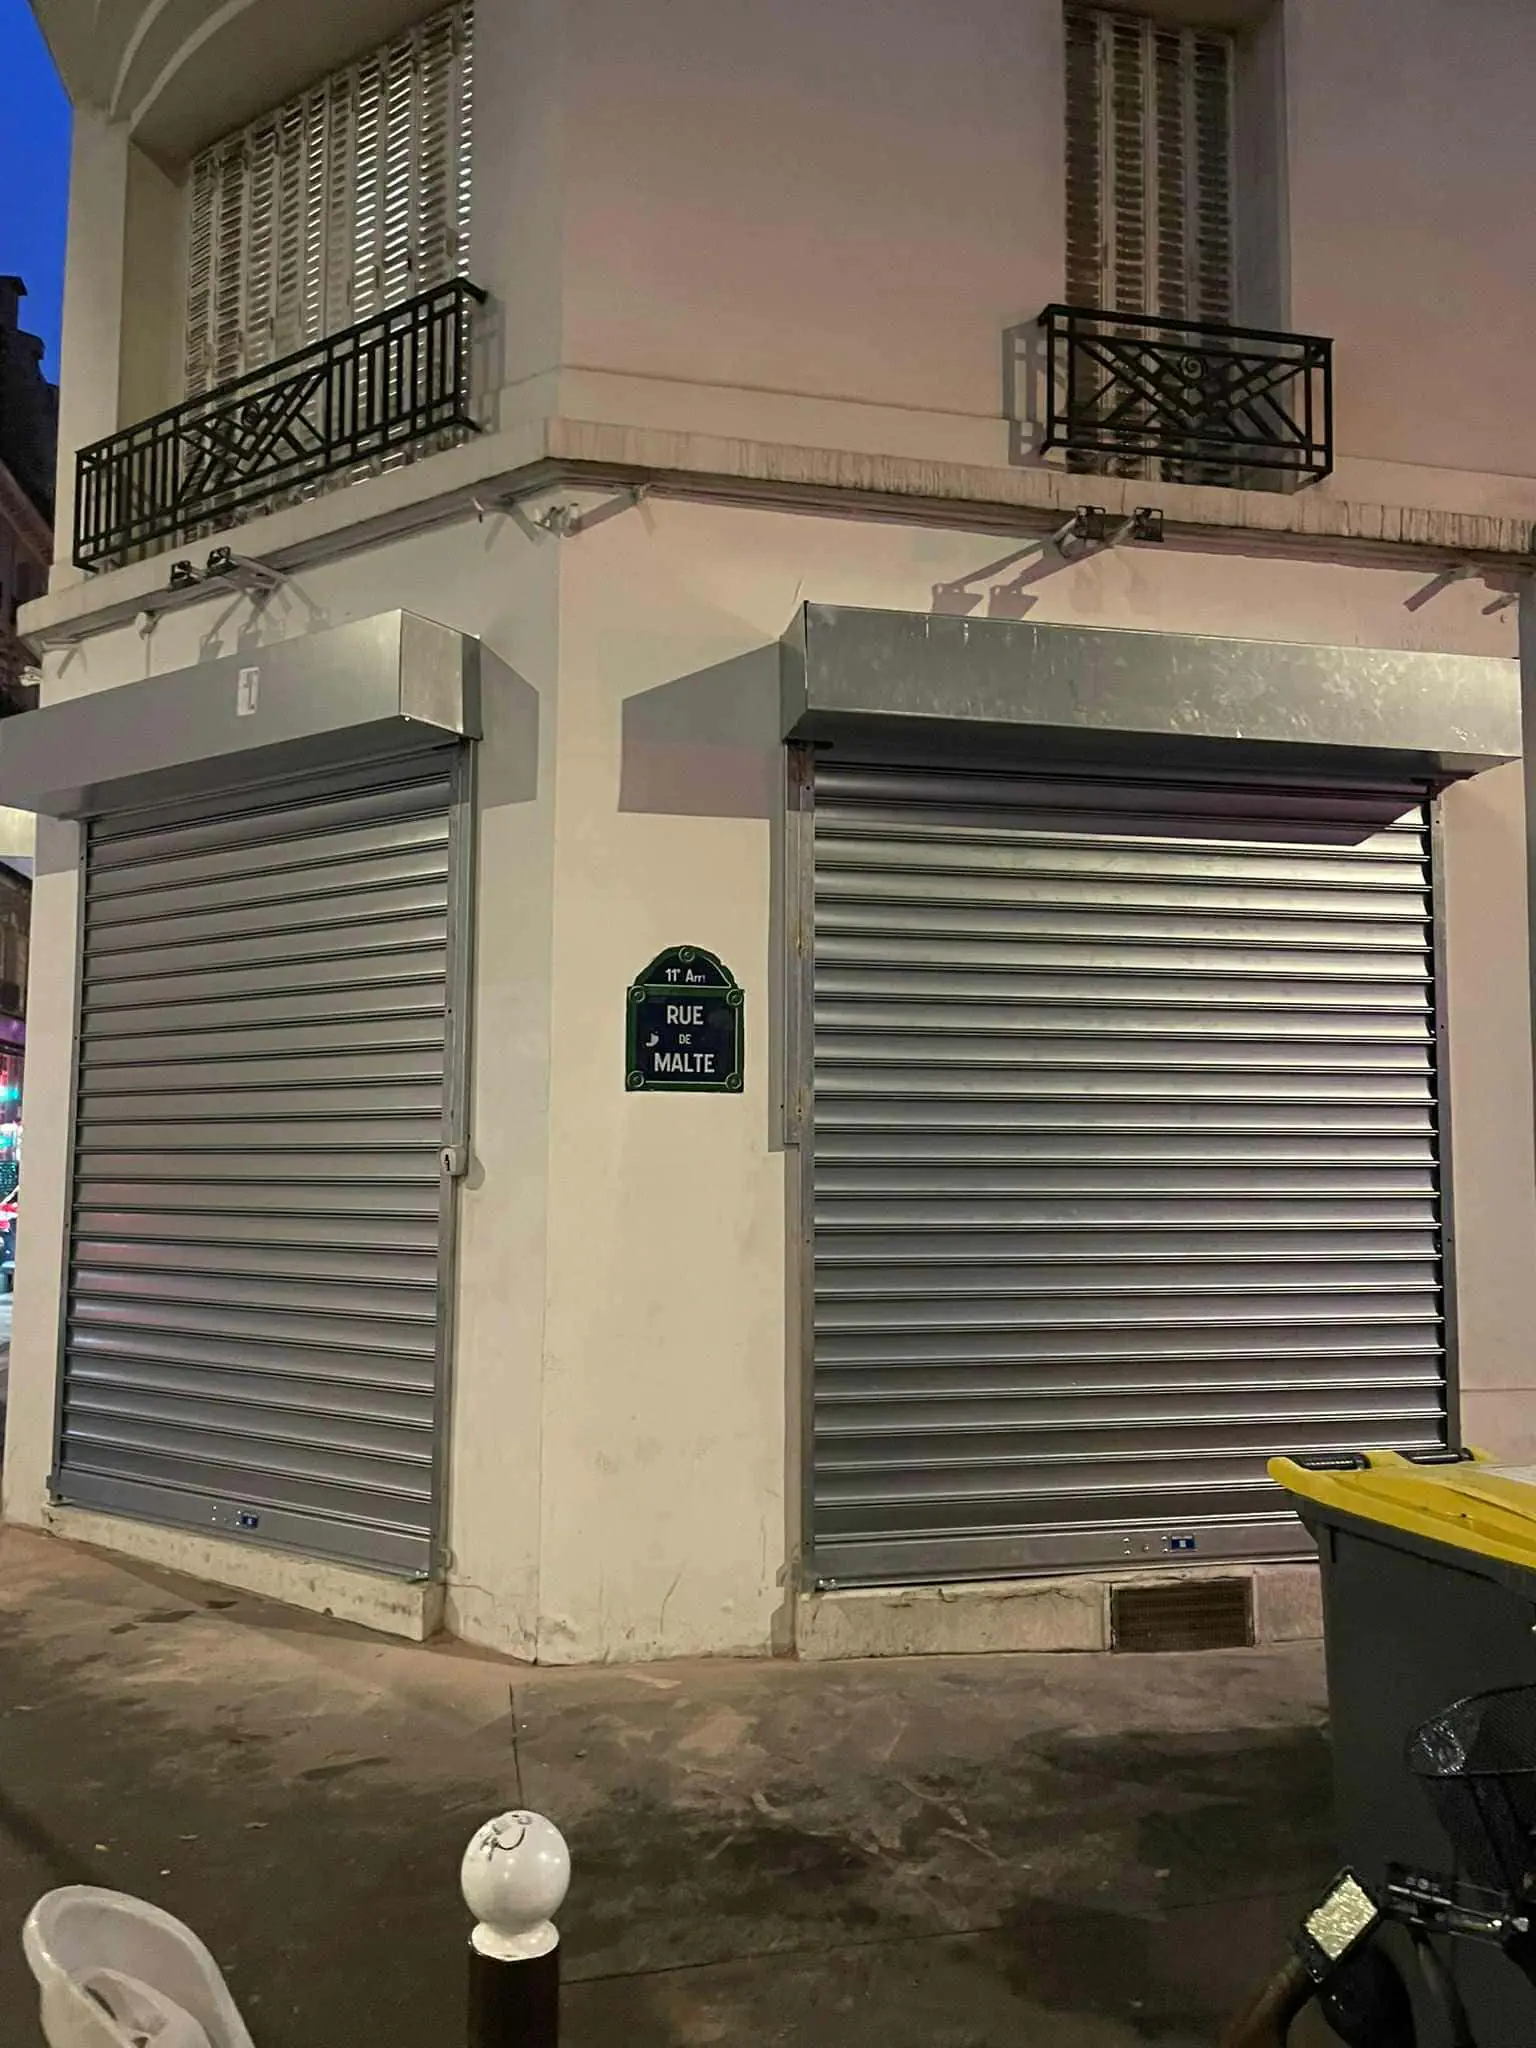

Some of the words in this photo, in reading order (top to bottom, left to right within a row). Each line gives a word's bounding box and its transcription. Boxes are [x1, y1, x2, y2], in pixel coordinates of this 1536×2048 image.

[667, 1005, 704, 1025] RUE
[678, 1034, 692, 1045] DE
[654, 1053, 715, 1073] MALTE
